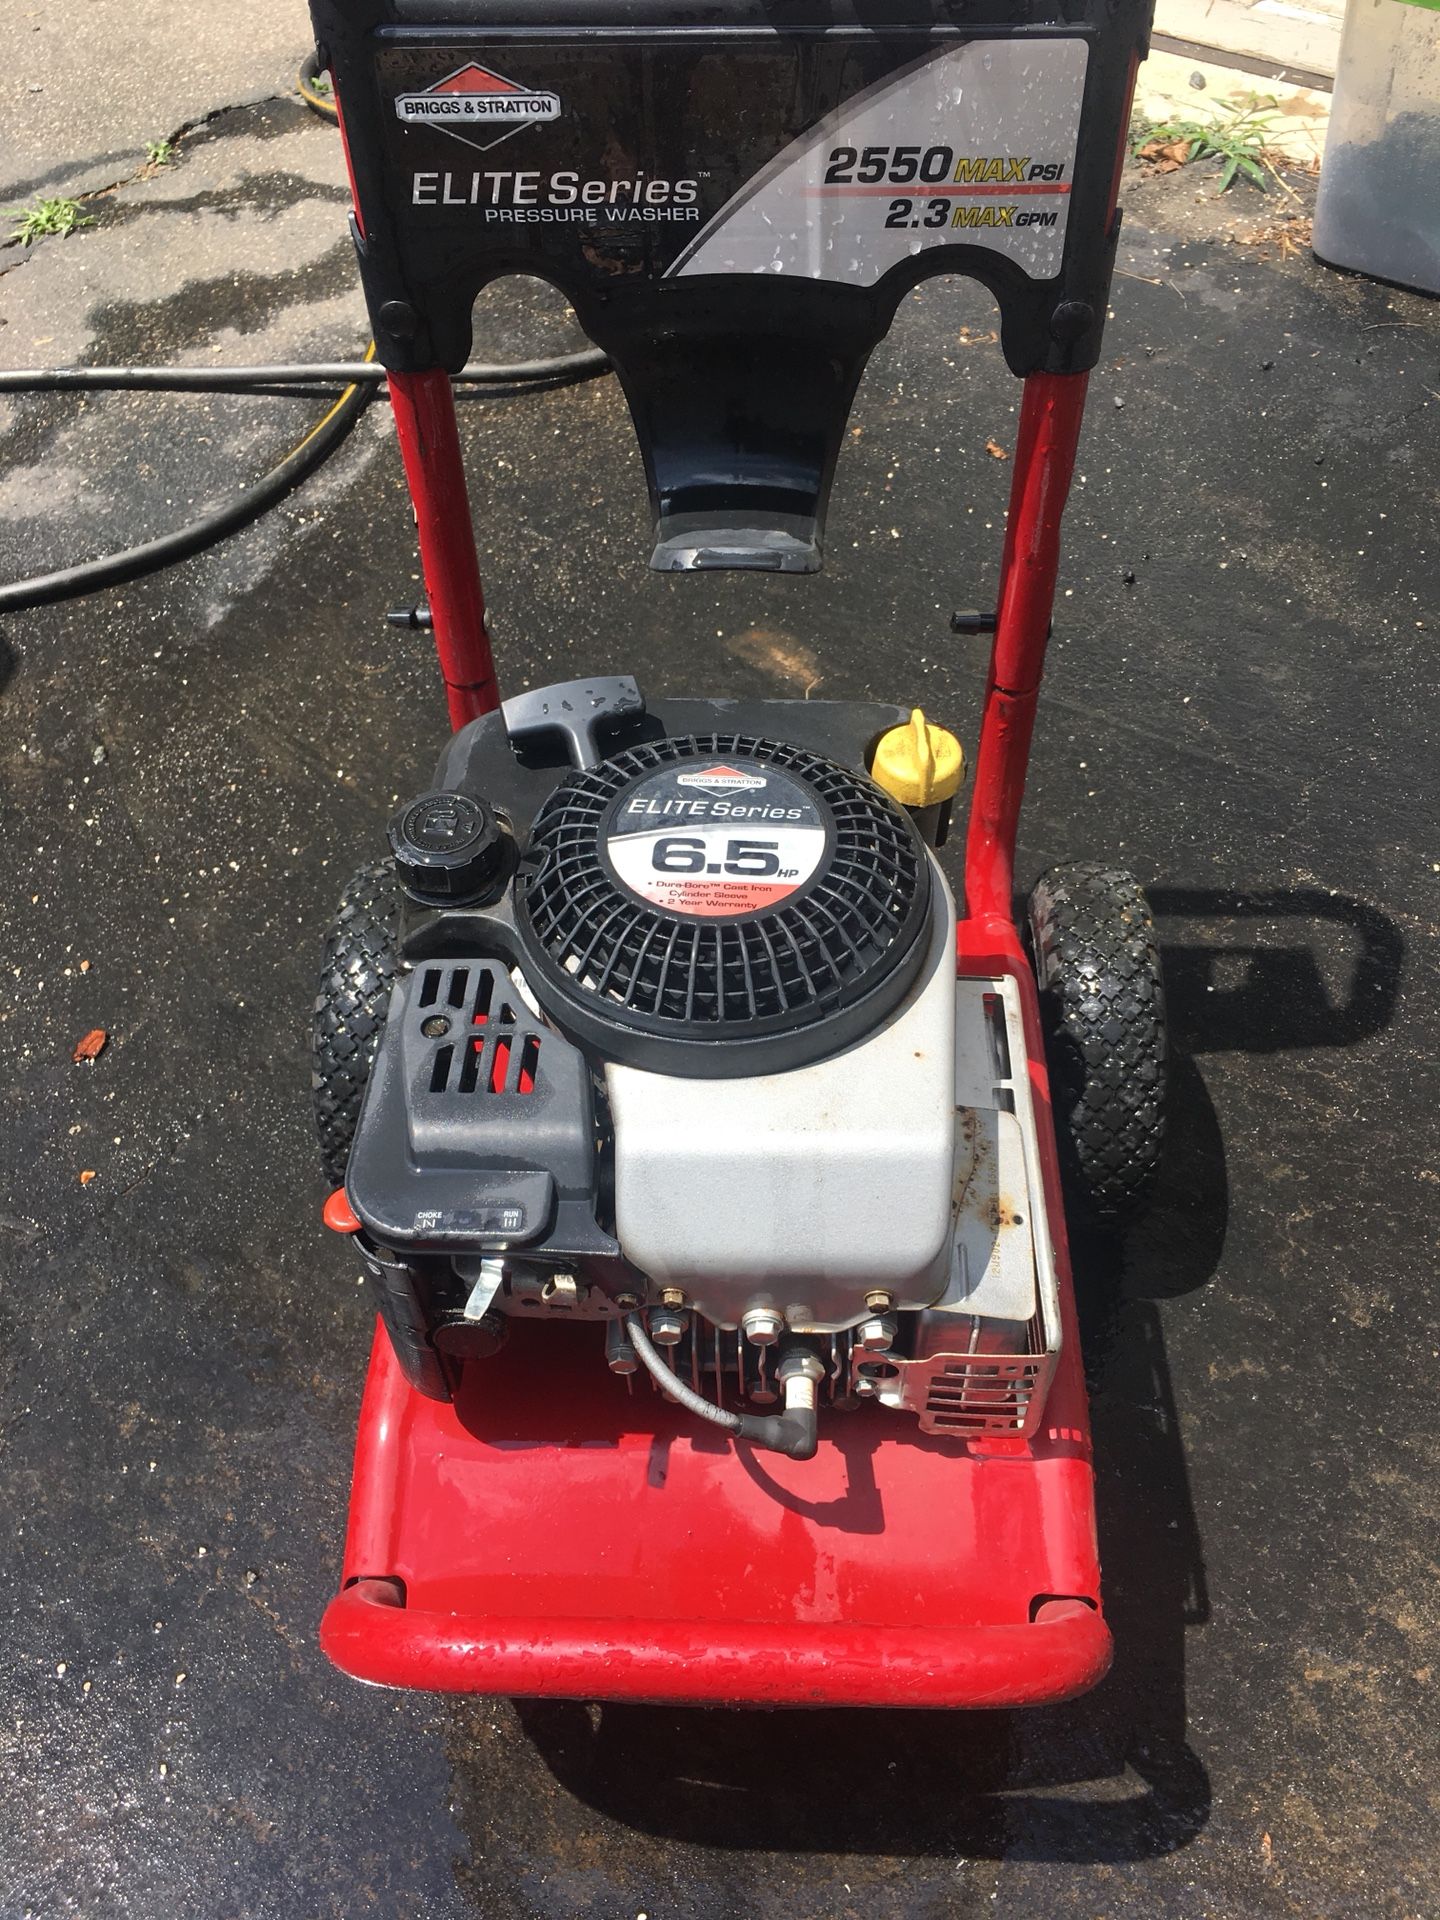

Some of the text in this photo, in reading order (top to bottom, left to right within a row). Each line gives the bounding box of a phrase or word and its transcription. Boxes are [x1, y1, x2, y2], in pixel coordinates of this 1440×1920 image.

[404, 99, 552, 115] BRIGGS & STRATTON
[824, 146, 1065, 184] 2550 MAX PSI
[411, 171, 541, 205] ELITE
[548, 170, 698, 205] Series
[485, 207, 700, 223] PRESSURE WASHER
[884, 198, 1058, 229] 2.3 MAX GPM
[720, 778, 762, 786] STRATTON
[627, 799, 709, 815] ELITE
[711, 802, 802, 819] Series
[651, 837, 799, 878] 6.5 HP
[669, 890, 748, 899] Cylinder Sleeve
[723, 883, 749, 891] Cast
[751, 884, 773, 892] Iron
[706, 900, 758, 909] Warranty
[417, 1210, 519, 1219] CHOKE RUN
